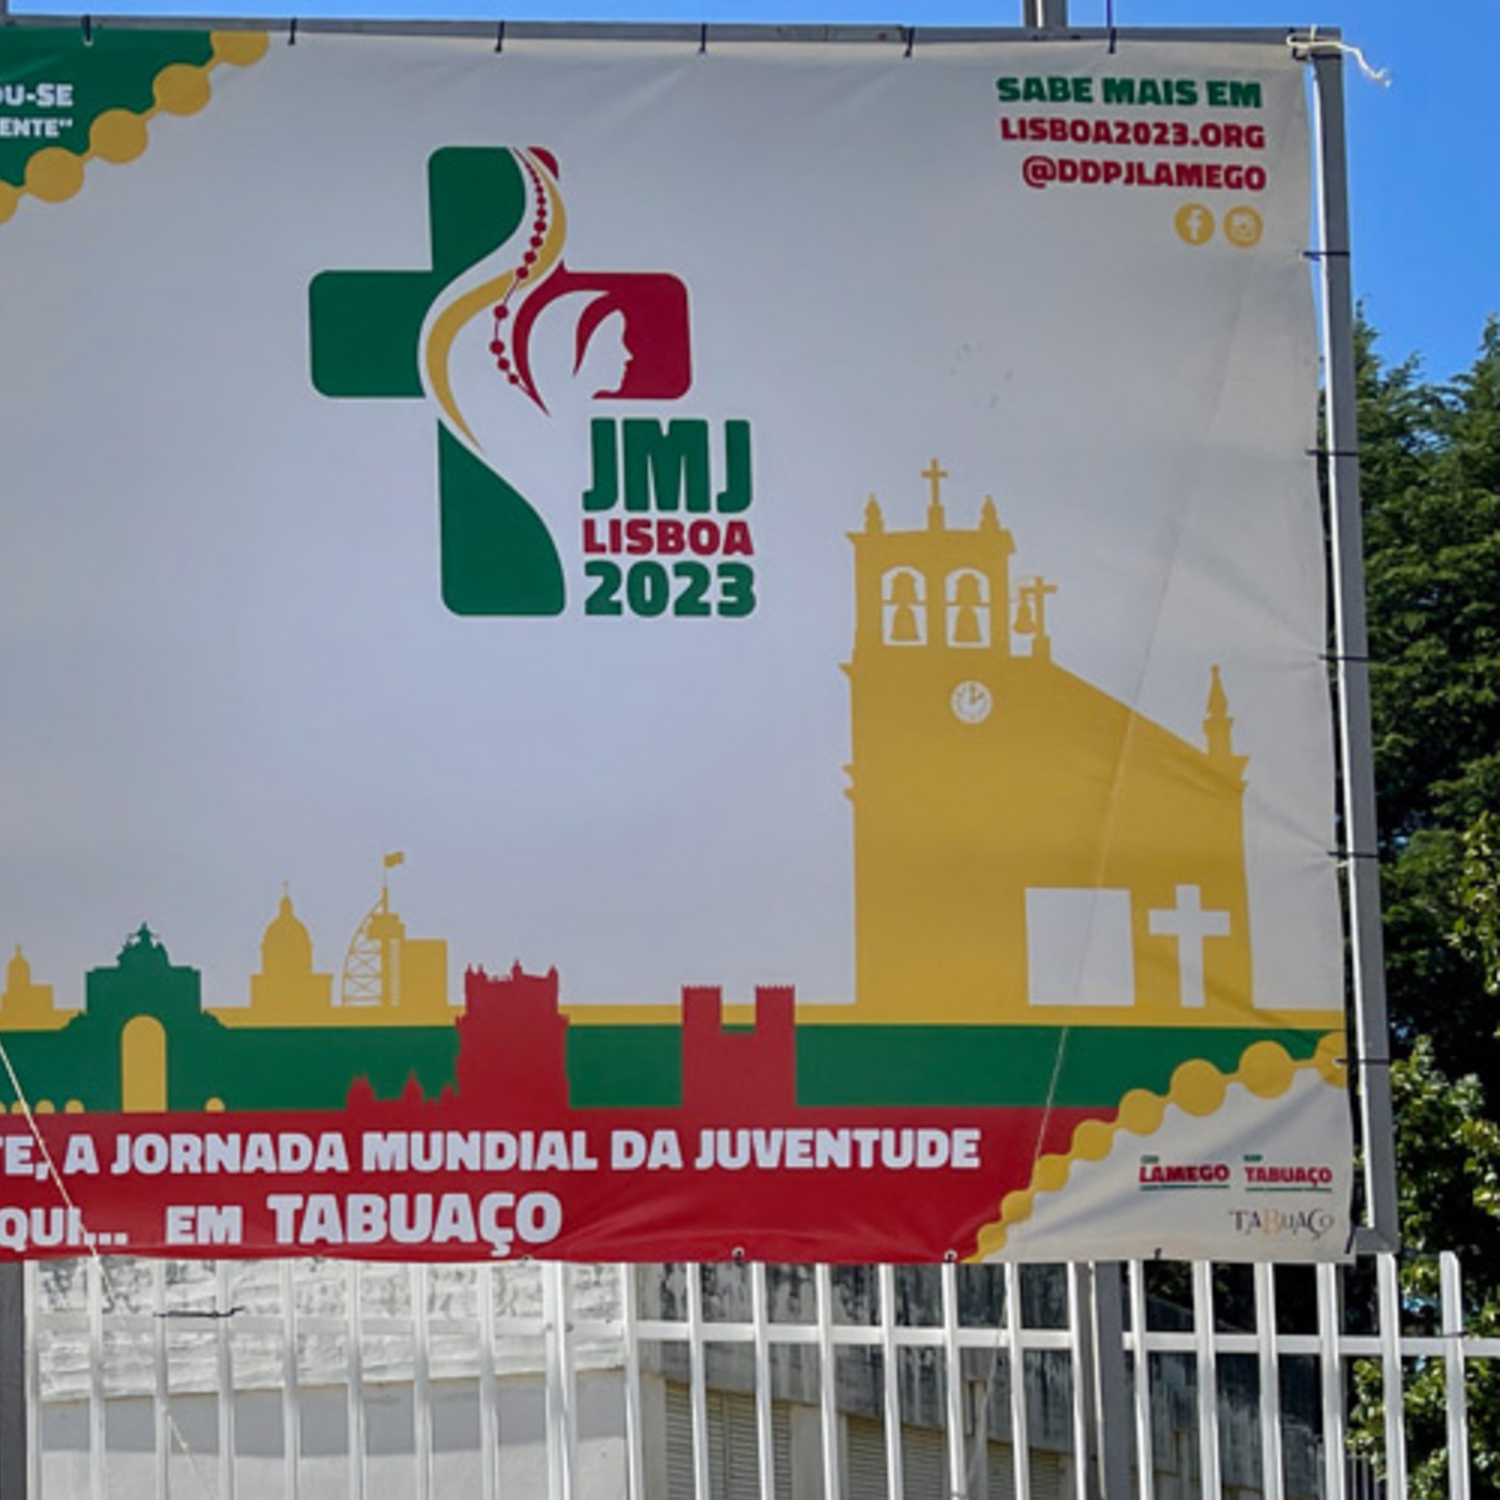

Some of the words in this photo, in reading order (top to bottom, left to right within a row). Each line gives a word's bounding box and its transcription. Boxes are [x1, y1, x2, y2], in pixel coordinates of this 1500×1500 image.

[996, 75, 1094, 103] SABE
[1102, 77, 1198, 106] MAIS
[1205, 79, 1263, 108] EM
[1000, 117, 1267, 150] LISBOA2023.ORG
[1022, 154, 1268, 192] @DDPJLAMEGO
[581, 416, 754, 514] JMJ
[582, 518, 755, 557] LISBOA
[583, 559, 758, 619] 2023
[62, 1133, 99, 1175] A
[110, 1131, 350, 1175] JORNADA
[362, 1129, 598, 1172] MUNDIAL
[610, 1128, 683, 1171] DA
[694, 1128, 982, 1171] JUVENTUDE
[1139, 1164, 1231, 1184] LAMEGO
[1244, 1166, 1333, 1188] TABUAÇO
[166, 1204, 243, 1247] EM
[266, 1191, 563, 1258] TABUAÇO
